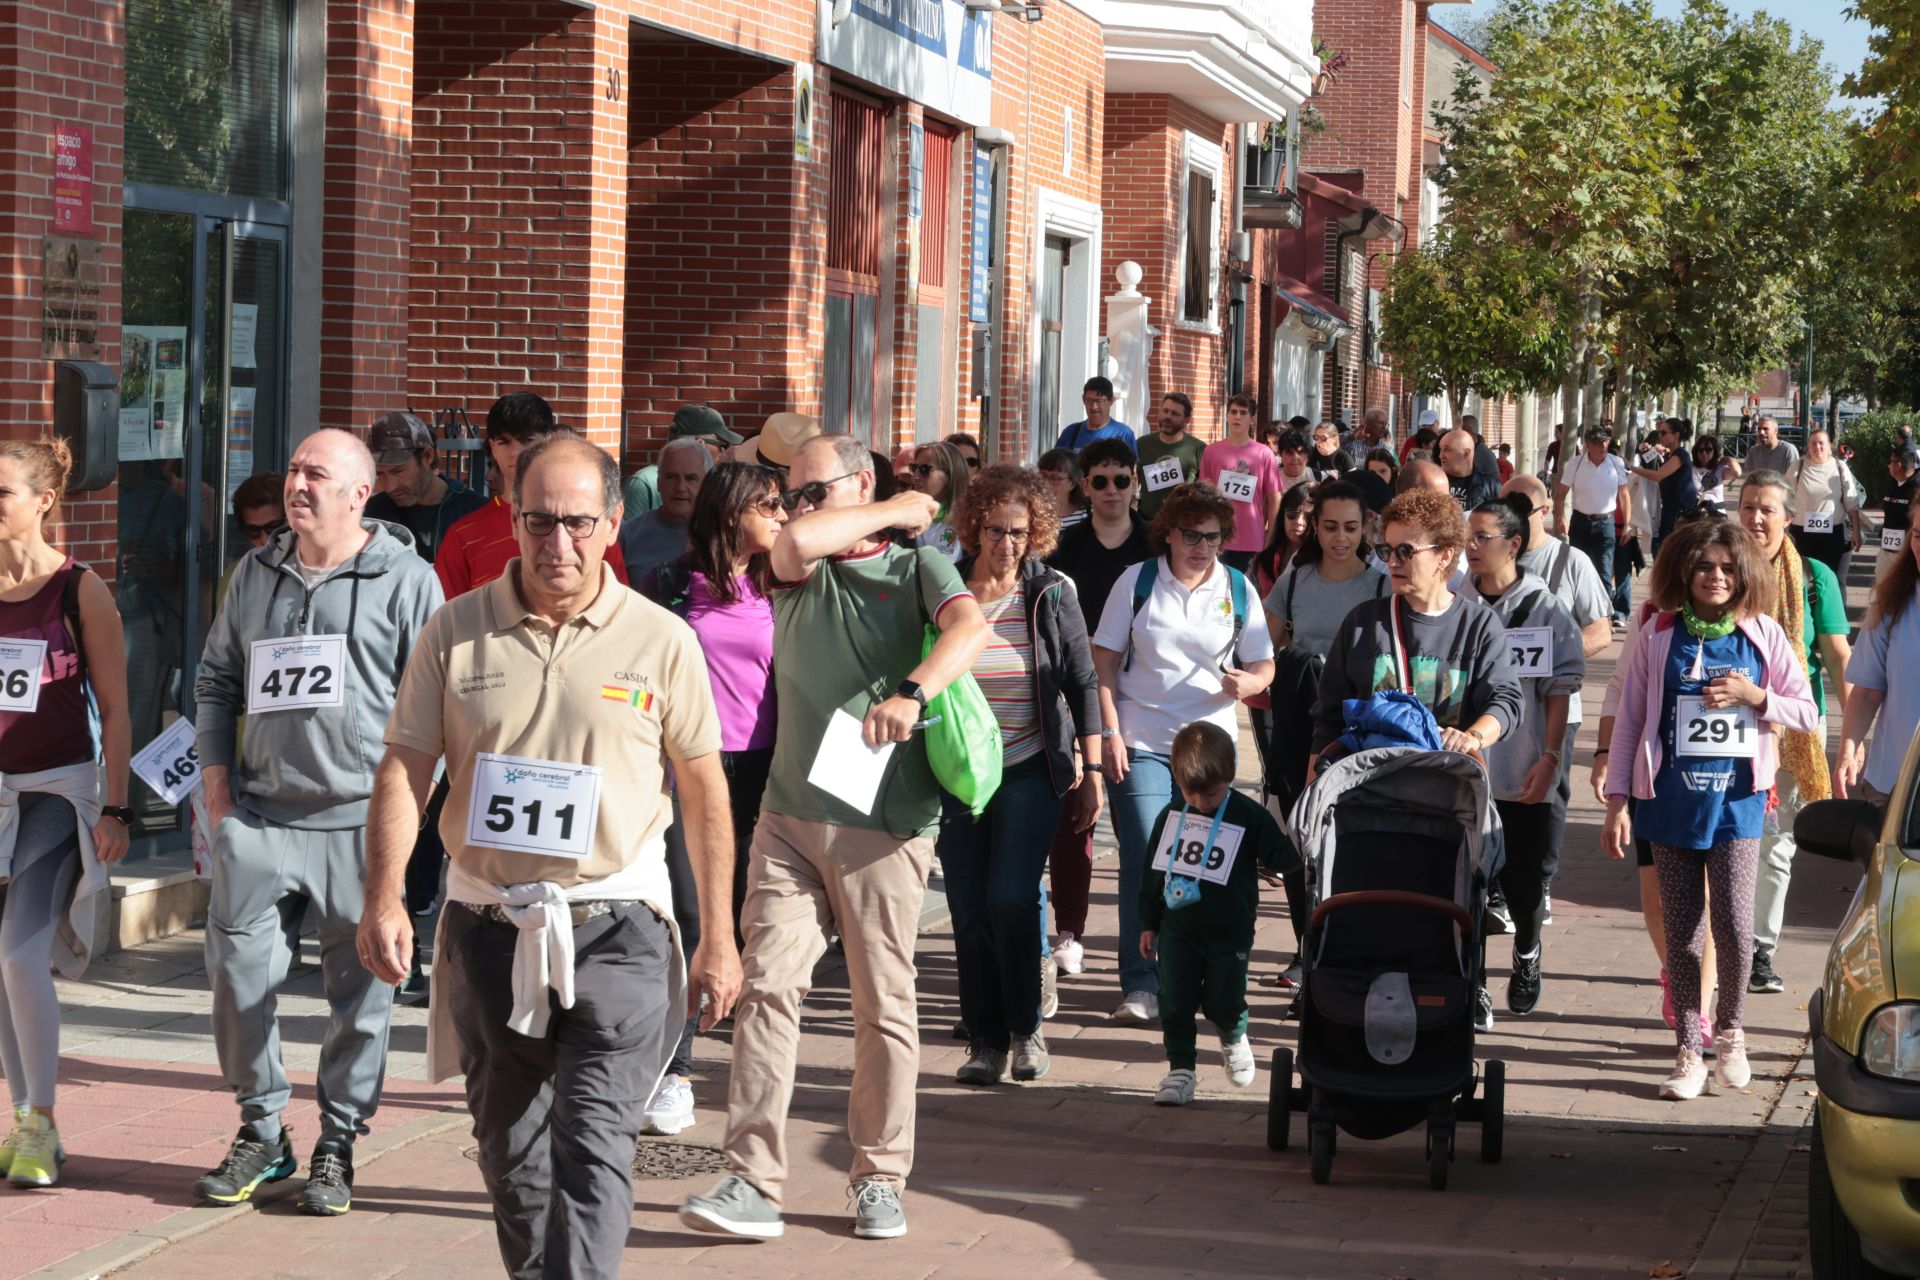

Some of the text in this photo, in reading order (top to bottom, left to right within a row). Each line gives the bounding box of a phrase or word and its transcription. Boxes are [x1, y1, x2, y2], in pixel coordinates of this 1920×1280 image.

[606, 67, 621, 102] 30
[57, 133, 81, 149] espacio
[57, 152, 76, 170] amigo
[1151, 468, 1178, 484] 186
[1223, 481, 1250, 496] 175
[1808, 519, 1830, 529] 205
[1883, 536, 1901, 546] 073
[614, 671, 648, 685] CASIM
[1738, 667, 1750, 676] DE
[0, 669, 29, 698] 6
[261, 665, 332, 698] 472
[1688, 718, 1745, 744] 291
[517, 769, 571, 781] daño cerebral
[485, 794, 576, 840] 511
[1165, 838, 1225, 871] 489
